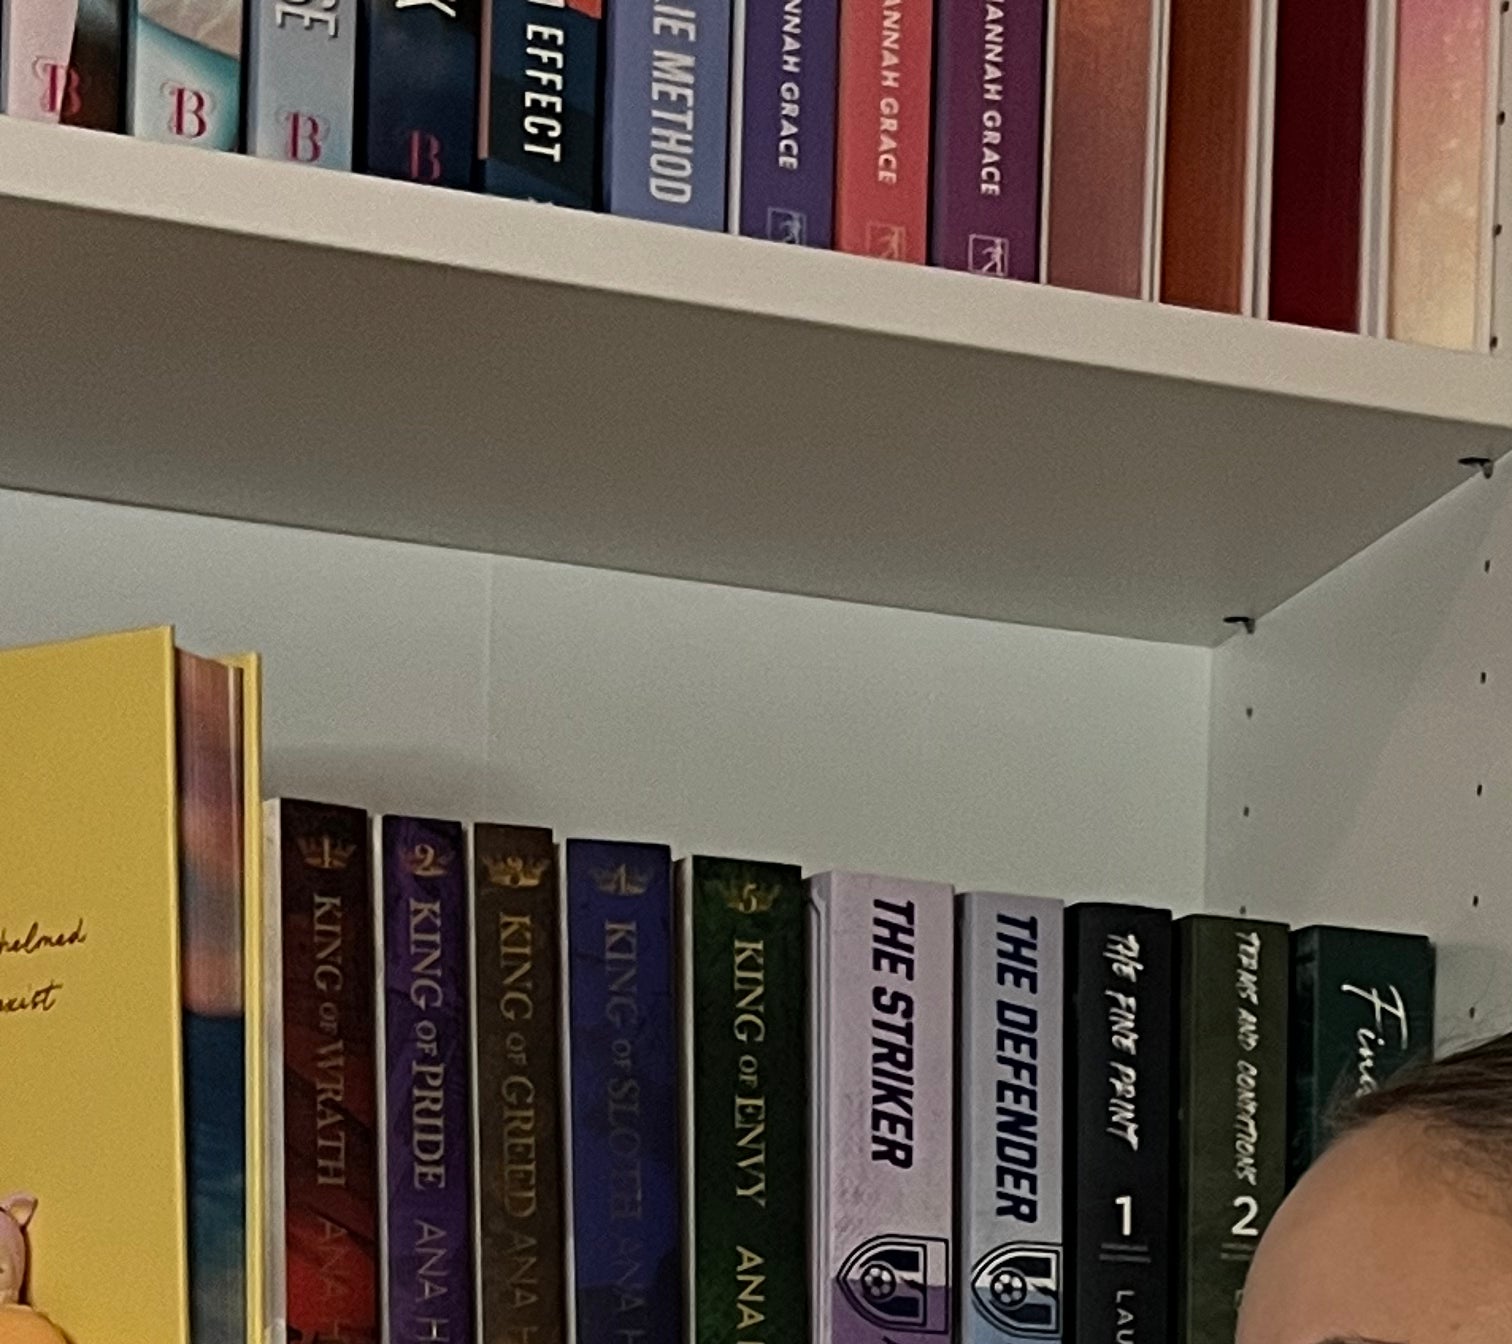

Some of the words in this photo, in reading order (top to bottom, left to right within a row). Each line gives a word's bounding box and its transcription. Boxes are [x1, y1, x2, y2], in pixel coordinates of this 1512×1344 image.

[524, 23, 564, 163] EFFECT
[650, 49, 696, 204] METHOD
[778, 82, 800, 170] GRACE
[877, 97, 899, 184] GRACE
[980, 109, 1003, 197] GRACE
[312, 894, 344, 993] KING
[408, 897, 443, 1011] KING
[499, 911, 534, 1022] KING
[604, 919, 639, 1026] KING
[873, 897, 915, 978] THE
[996, 912, 1038, 994] THE
[1235, 931, 1261, 1006] TERMS
[413, 1019, 438, 1057] OF
[734, 938, 766, 1046] KING
[1237, 1007, 1260, 1052] AND
[315, 1038, 346, 1188] WRATH
[738, 1053, 759, 1088] OF
[871, 984, 915, 1171] STRIKER
[995, 1010, 1038, 1225] DEFENDER
[1107, 1061, 1140, 1151] PRINT
[412, 1060, 446, 1191] PRIDE
[500, 1075, 538, 1218] GREED
[735, 1094, 767, 1209] ENVY
[1234, 1059, 1258, 1186] CONDITIONS
[413, 1218, 448, 1302] ANA
[1114, 1195, 1134, 1236] 1
[1230, 1195, 1259, 1237] 2
[736, 1244, 765, 1331] ANA
